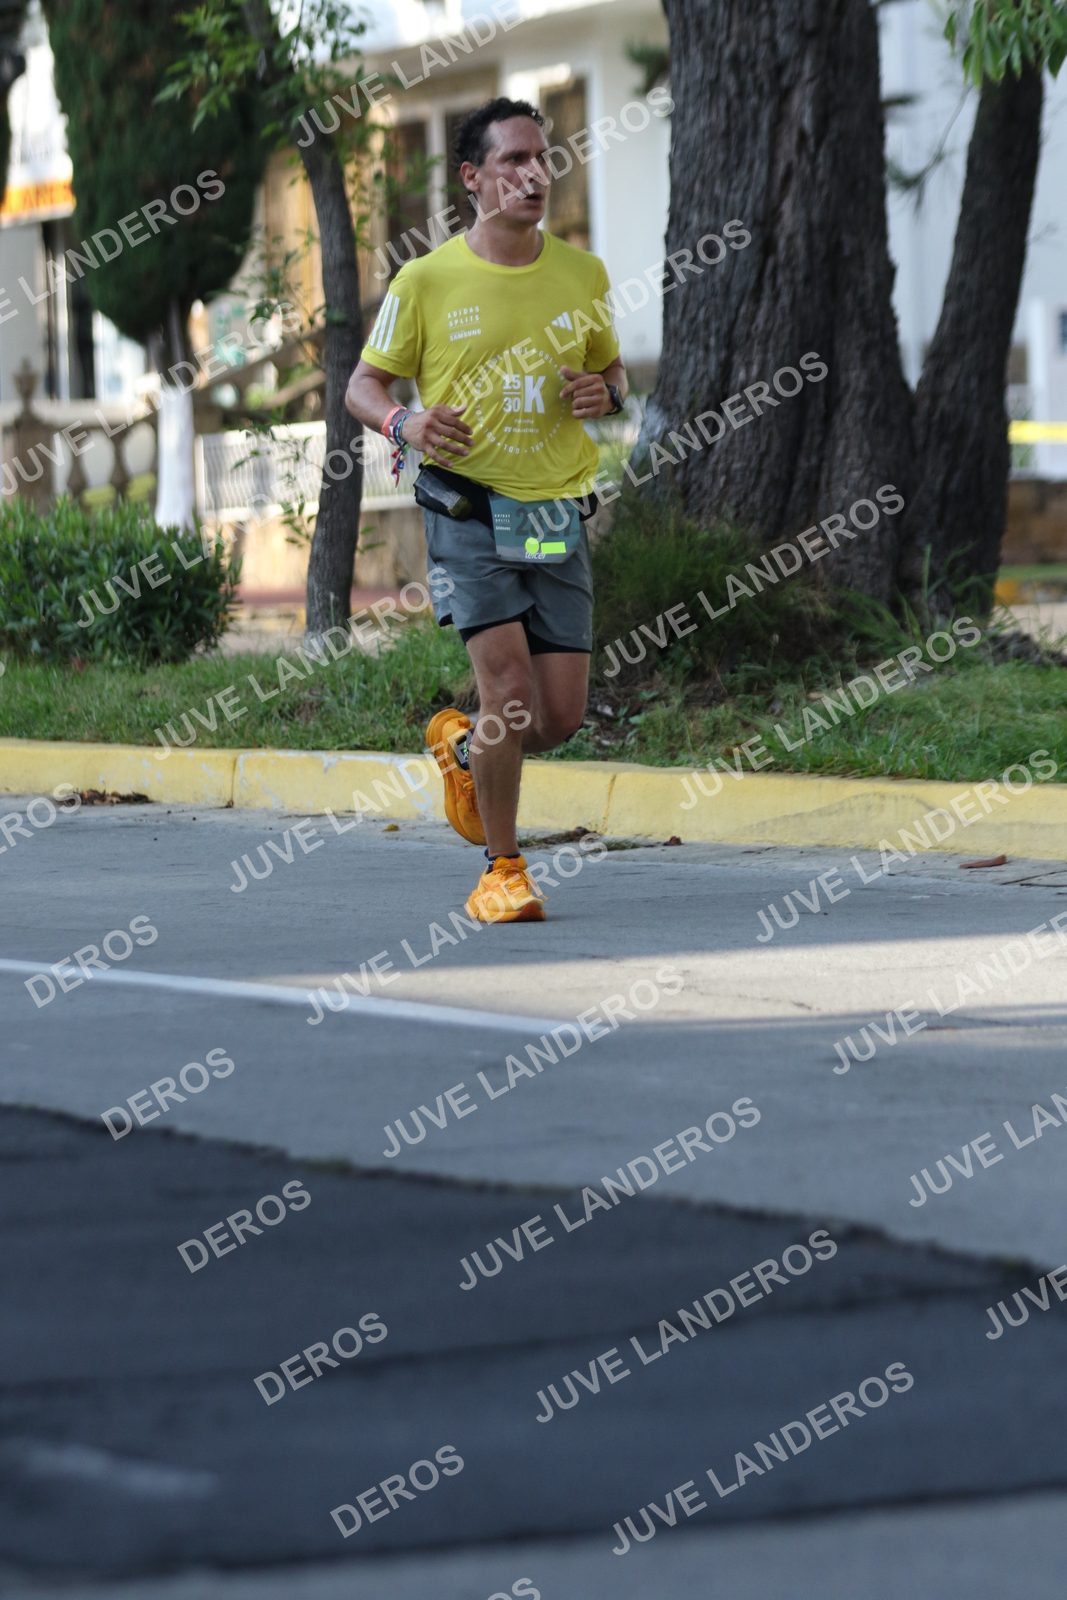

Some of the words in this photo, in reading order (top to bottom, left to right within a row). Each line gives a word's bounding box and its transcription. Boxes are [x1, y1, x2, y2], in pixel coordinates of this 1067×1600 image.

[503, 374, 520, 389] 15
[524, 375, 546, 414] K
[503, 397, 520, 413] 30
